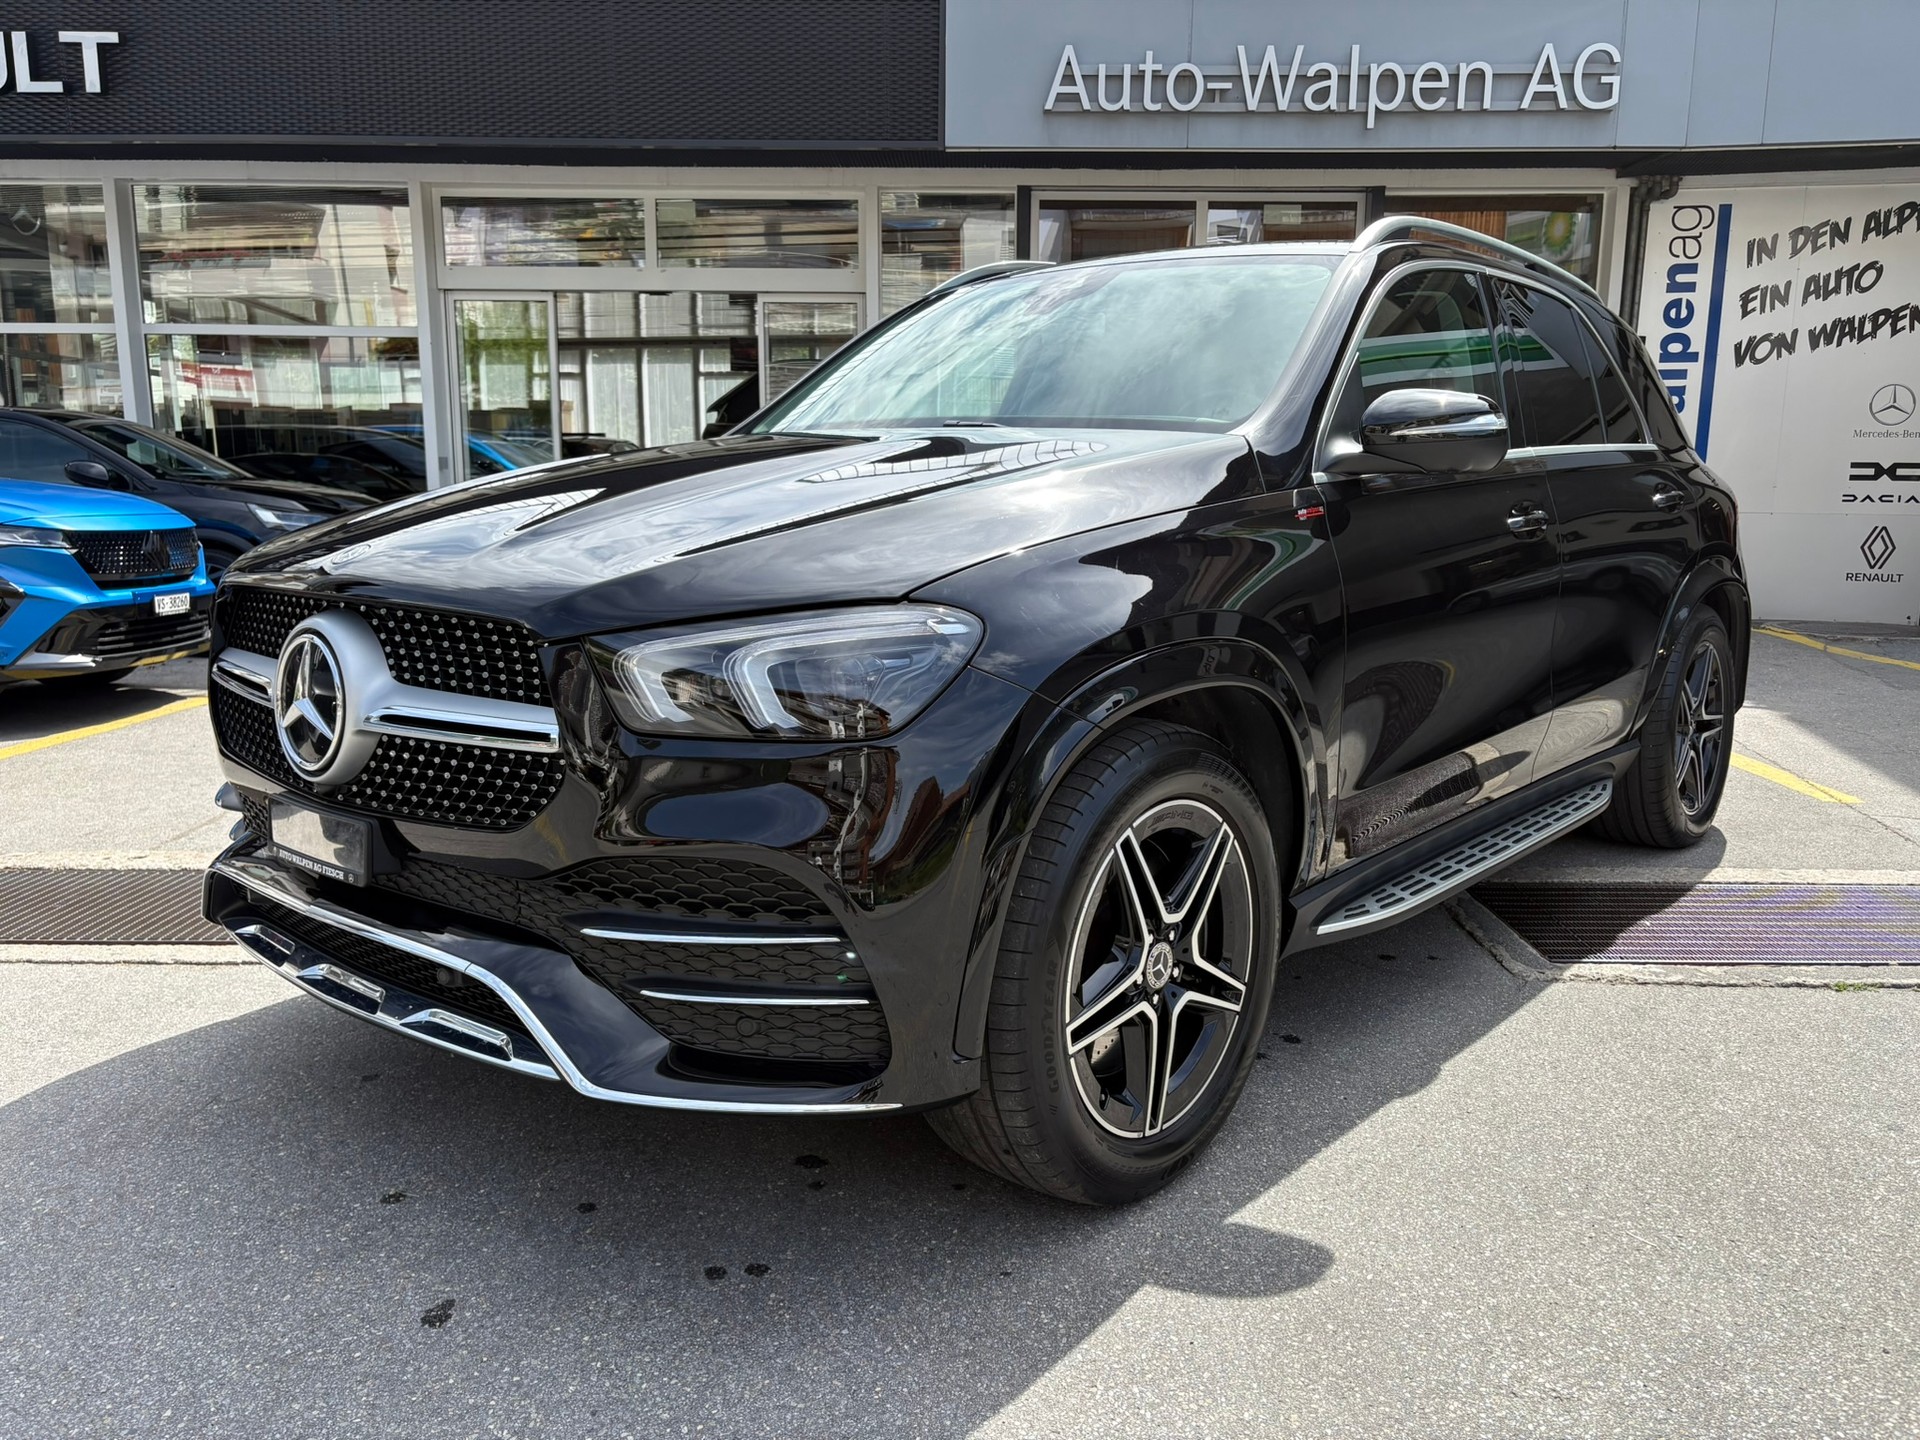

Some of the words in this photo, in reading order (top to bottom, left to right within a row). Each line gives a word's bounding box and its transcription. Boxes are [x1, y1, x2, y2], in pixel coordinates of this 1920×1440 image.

[0, 31, 119, 93] LT
[1044, 44, 1494, 129] Auto-Walpen
[1520, 42, 1622, 110] AG
[1746, 232, 1779, 269] IN
[1788, 216, 1853, 260] DEN
[1861, 200, 1920, 245] ALP
[1739, 279, 1792, 320] EIN
[1801, 260, 1884, 307] AUTO
[1733, 327, 1799, 369] VON
[1842, 494, 1920, 503] DACIA
[1846, 573, 1904, 583] RENAULT
[313, 861, 322, 873] AG
